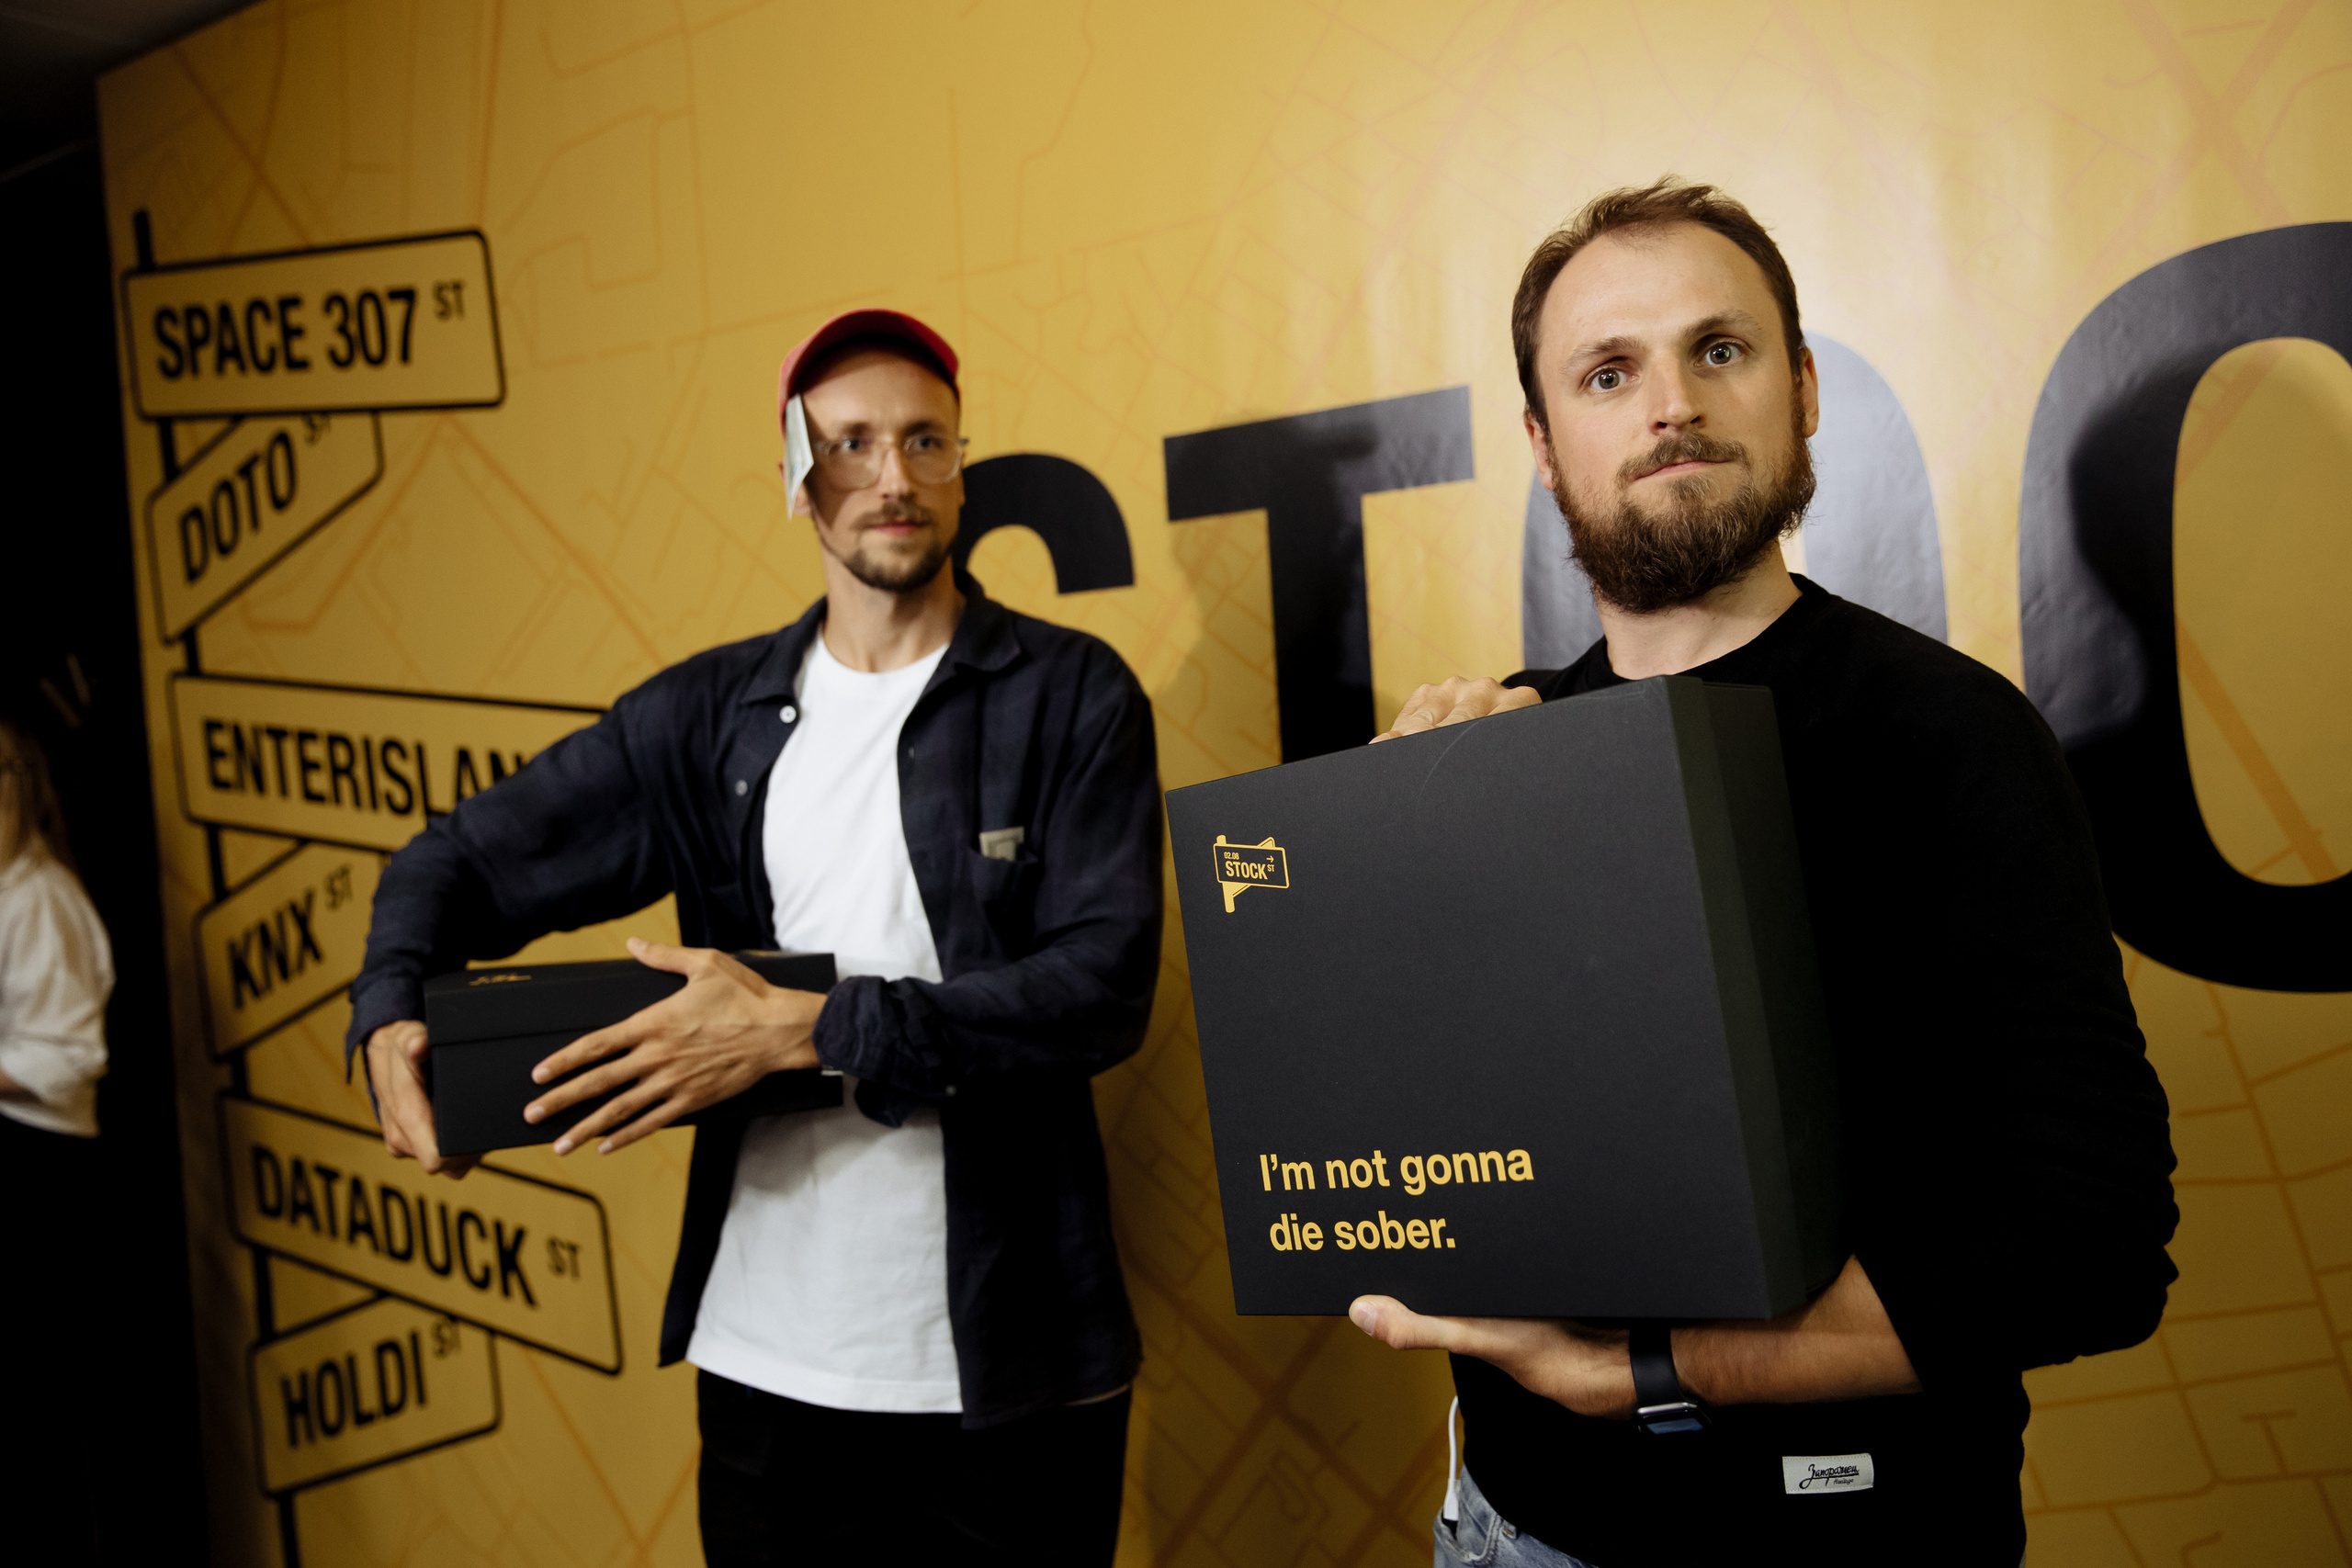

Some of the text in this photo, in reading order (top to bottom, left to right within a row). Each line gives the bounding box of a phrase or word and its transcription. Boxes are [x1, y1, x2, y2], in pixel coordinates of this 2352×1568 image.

[154, 281, 466, 381] SPACE 307 ST
[179, 431, 297, 585] DOTO
[1225, 861, 1268, 880] STOCK
[226, 863, 353, 1011] KNX ST
[1260, 1148, 1534, 1196] I’m not gonna
[251, 1143, 582, 1312] DATADUCK ST
[1269, 1210, 1456, 1251] die sober.
[281, 1331, 427, 1450] HOLDI
